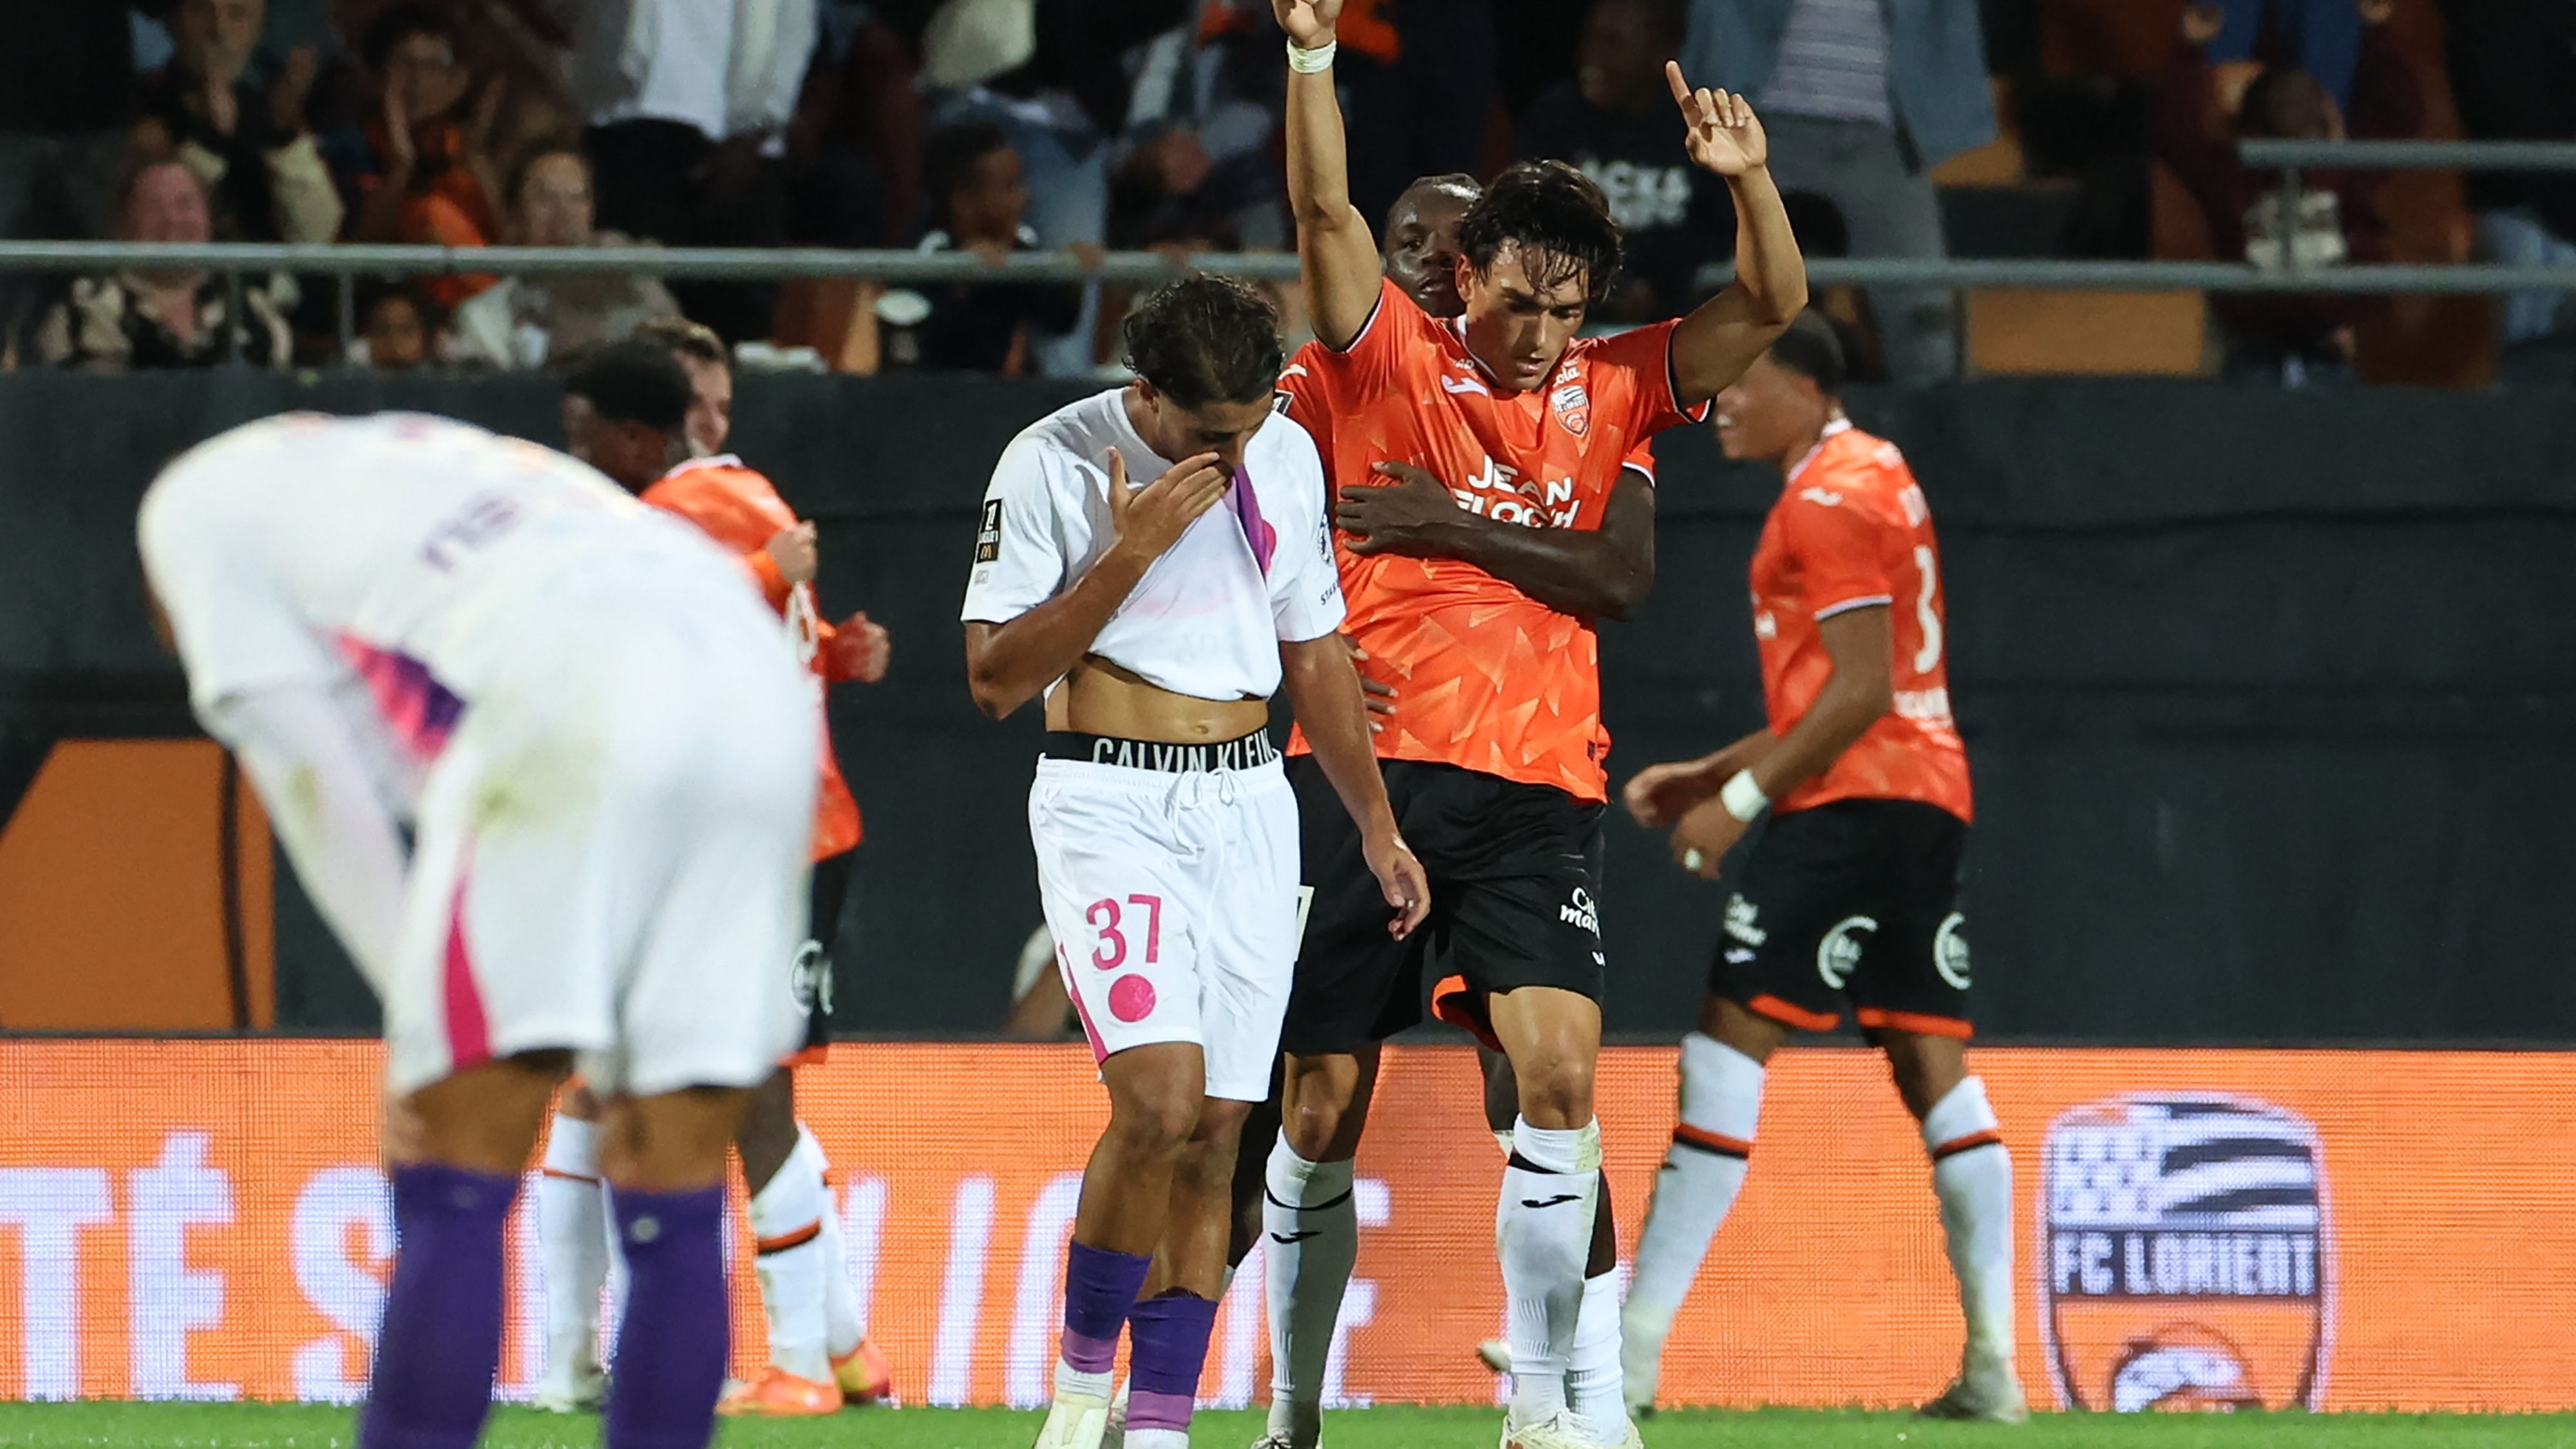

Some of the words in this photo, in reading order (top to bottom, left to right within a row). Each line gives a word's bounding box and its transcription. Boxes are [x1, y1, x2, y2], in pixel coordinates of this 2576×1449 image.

[1468, 455, 1572, 506] JEAN
[1094, 738, 1206, 773] CALVIN
[1218, 728, 1274, 771] KLEIN
[1086, 894, 1161, 971] 37
[2054, 1231, 2114, 1294] FC
[2125, 1231, 2316, 1296] LORIENT
